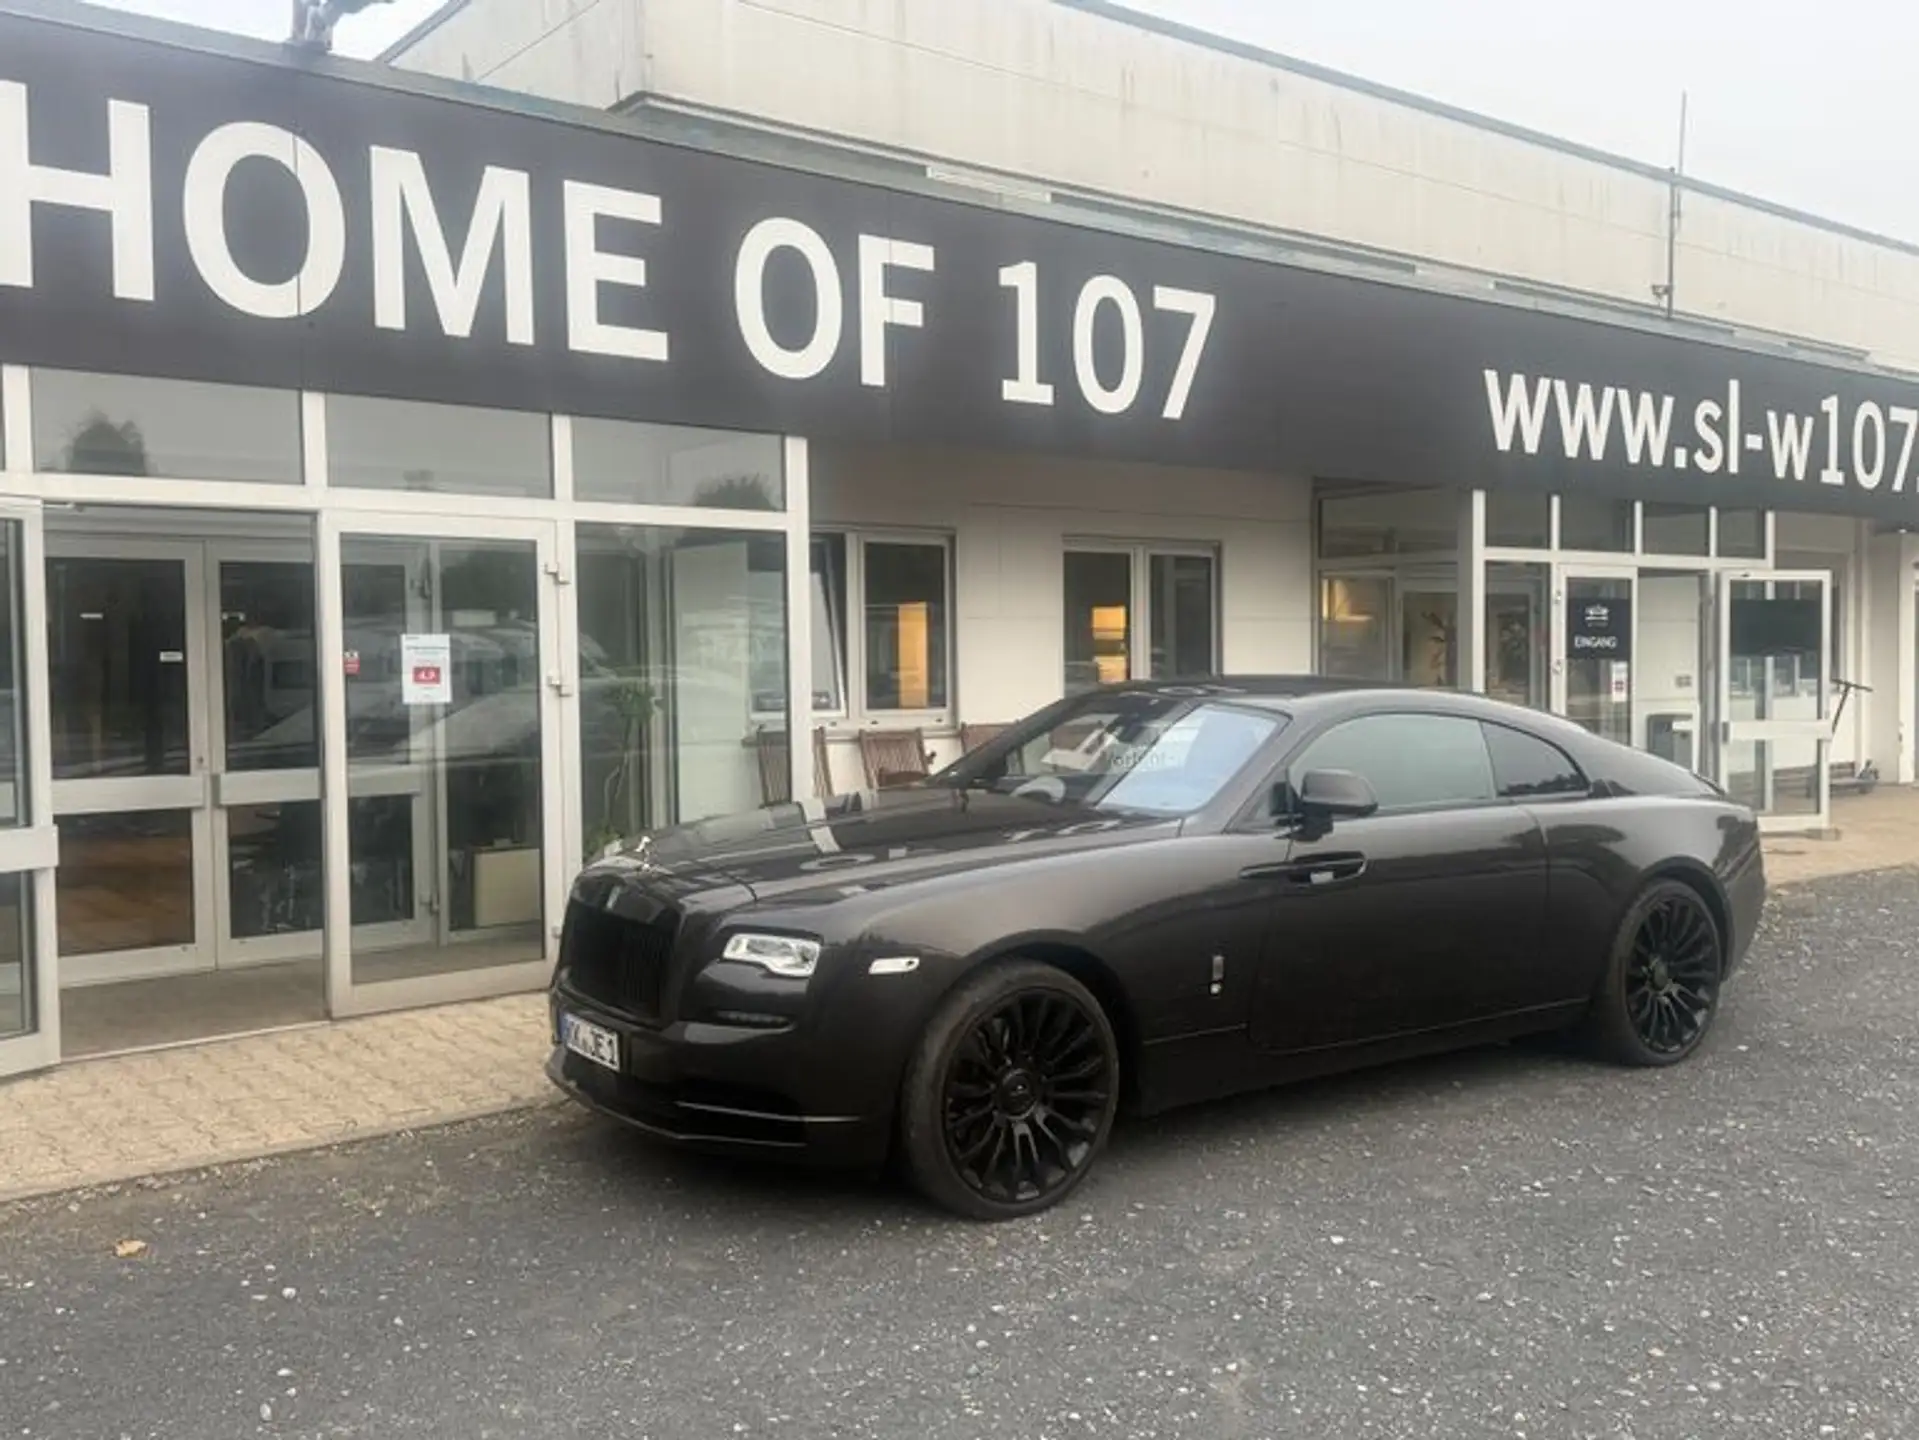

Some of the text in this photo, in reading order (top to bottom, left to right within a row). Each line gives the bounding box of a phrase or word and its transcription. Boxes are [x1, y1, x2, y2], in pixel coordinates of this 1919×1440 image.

[0, 79, 1216, 420] HOME OF 107
[1484, 368, 1919, 493] www.sl-w107
[1574, 635, 1617, 648] EINGANG
